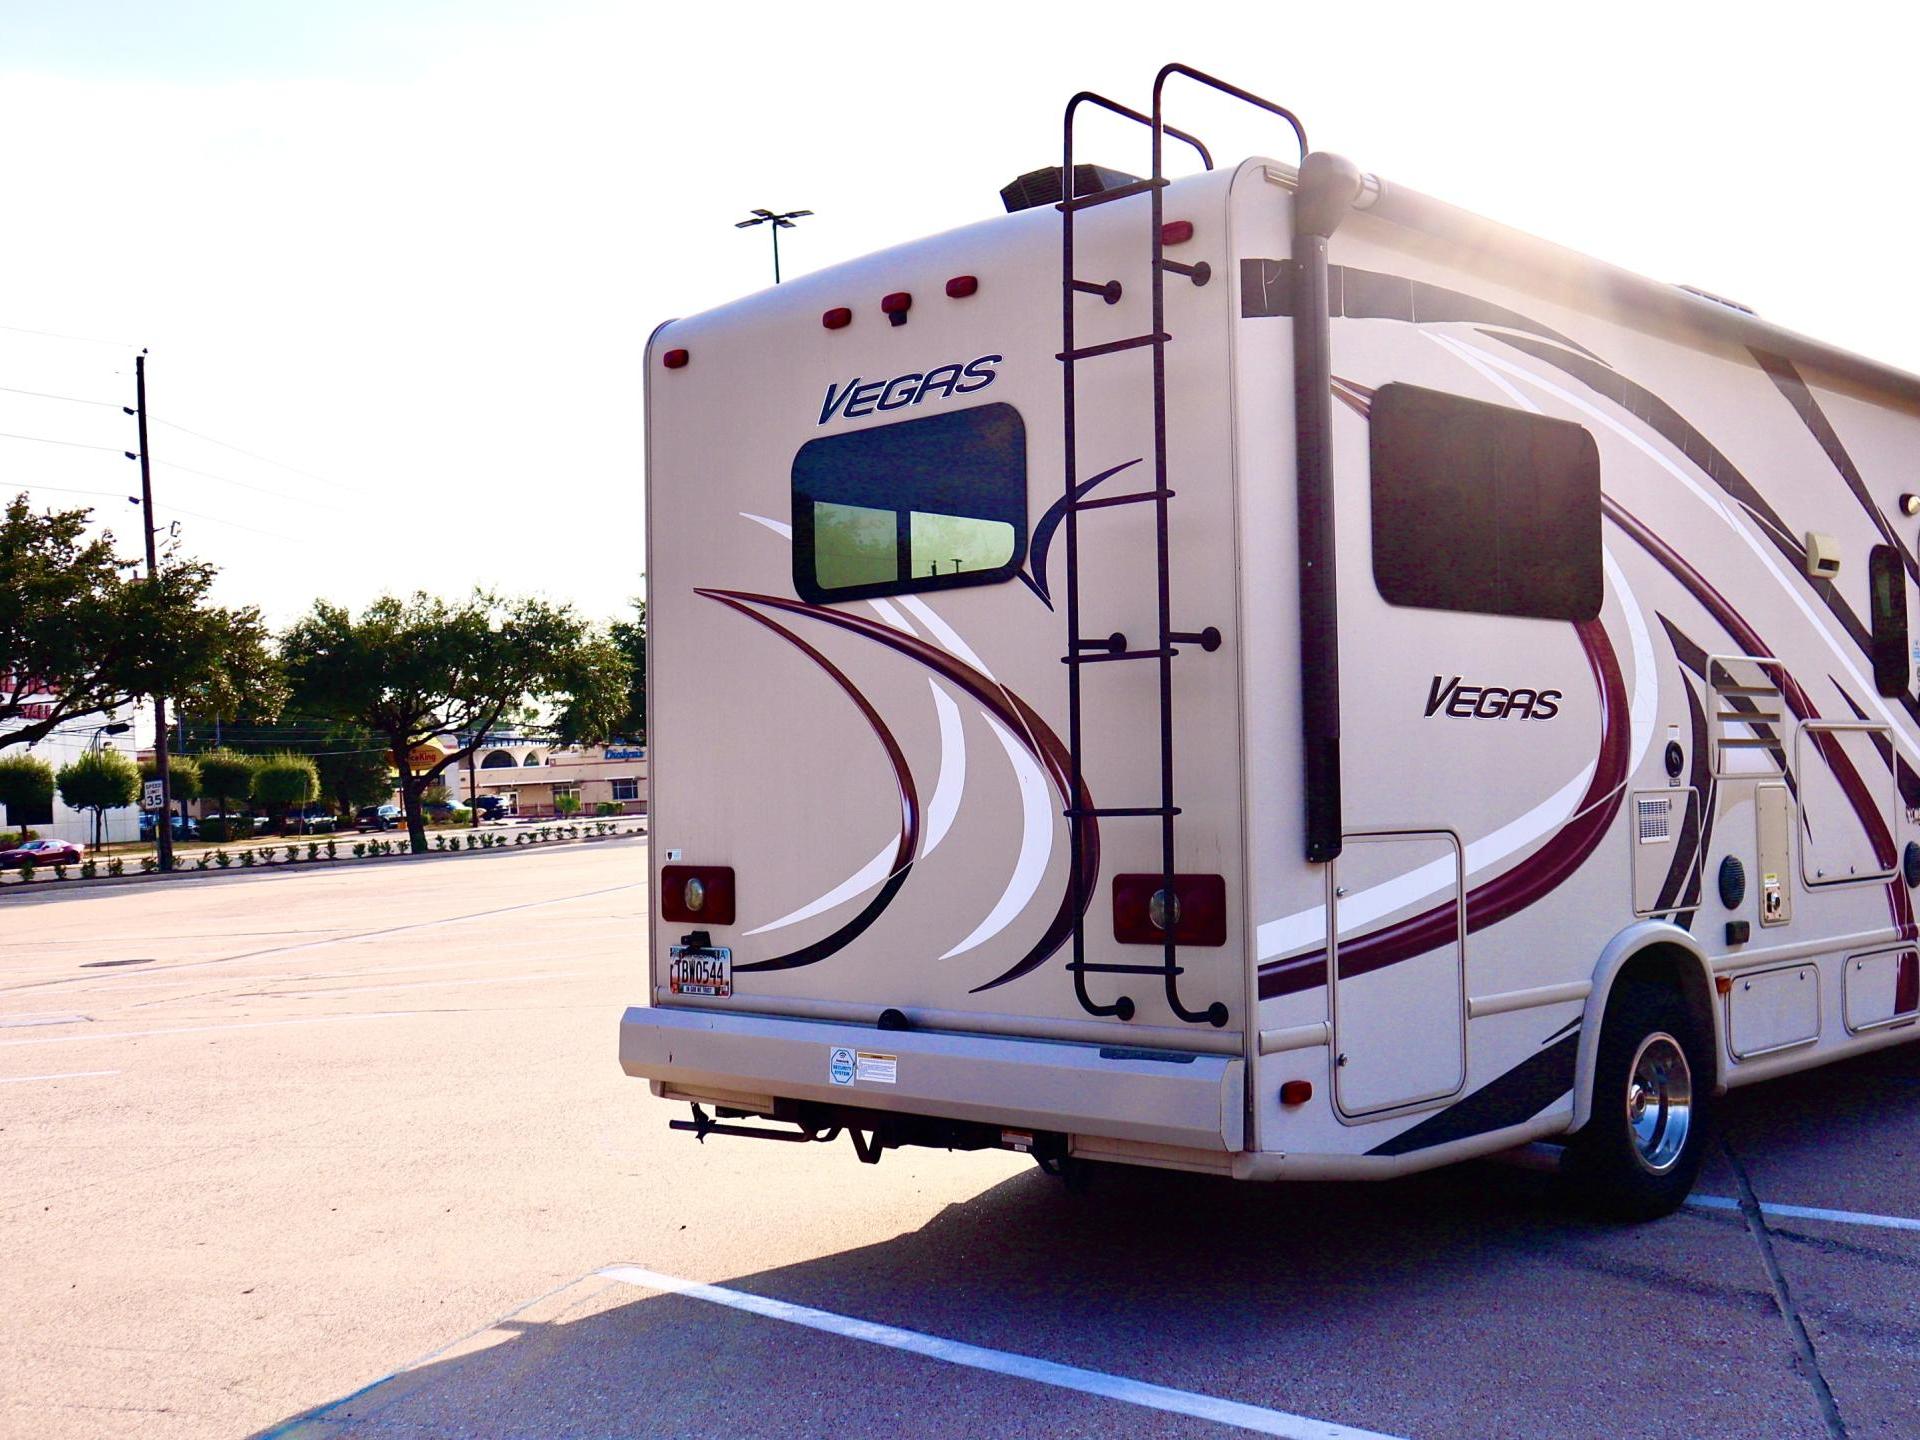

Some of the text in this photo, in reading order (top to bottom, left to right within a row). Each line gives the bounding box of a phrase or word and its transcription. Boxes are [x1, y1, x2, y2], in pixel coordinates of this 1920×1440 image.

[817, 354, 1003, 426] VEGAS
[1424, 675, 1562, 720] VEGAS
[147, 794, 163, 806] 35
